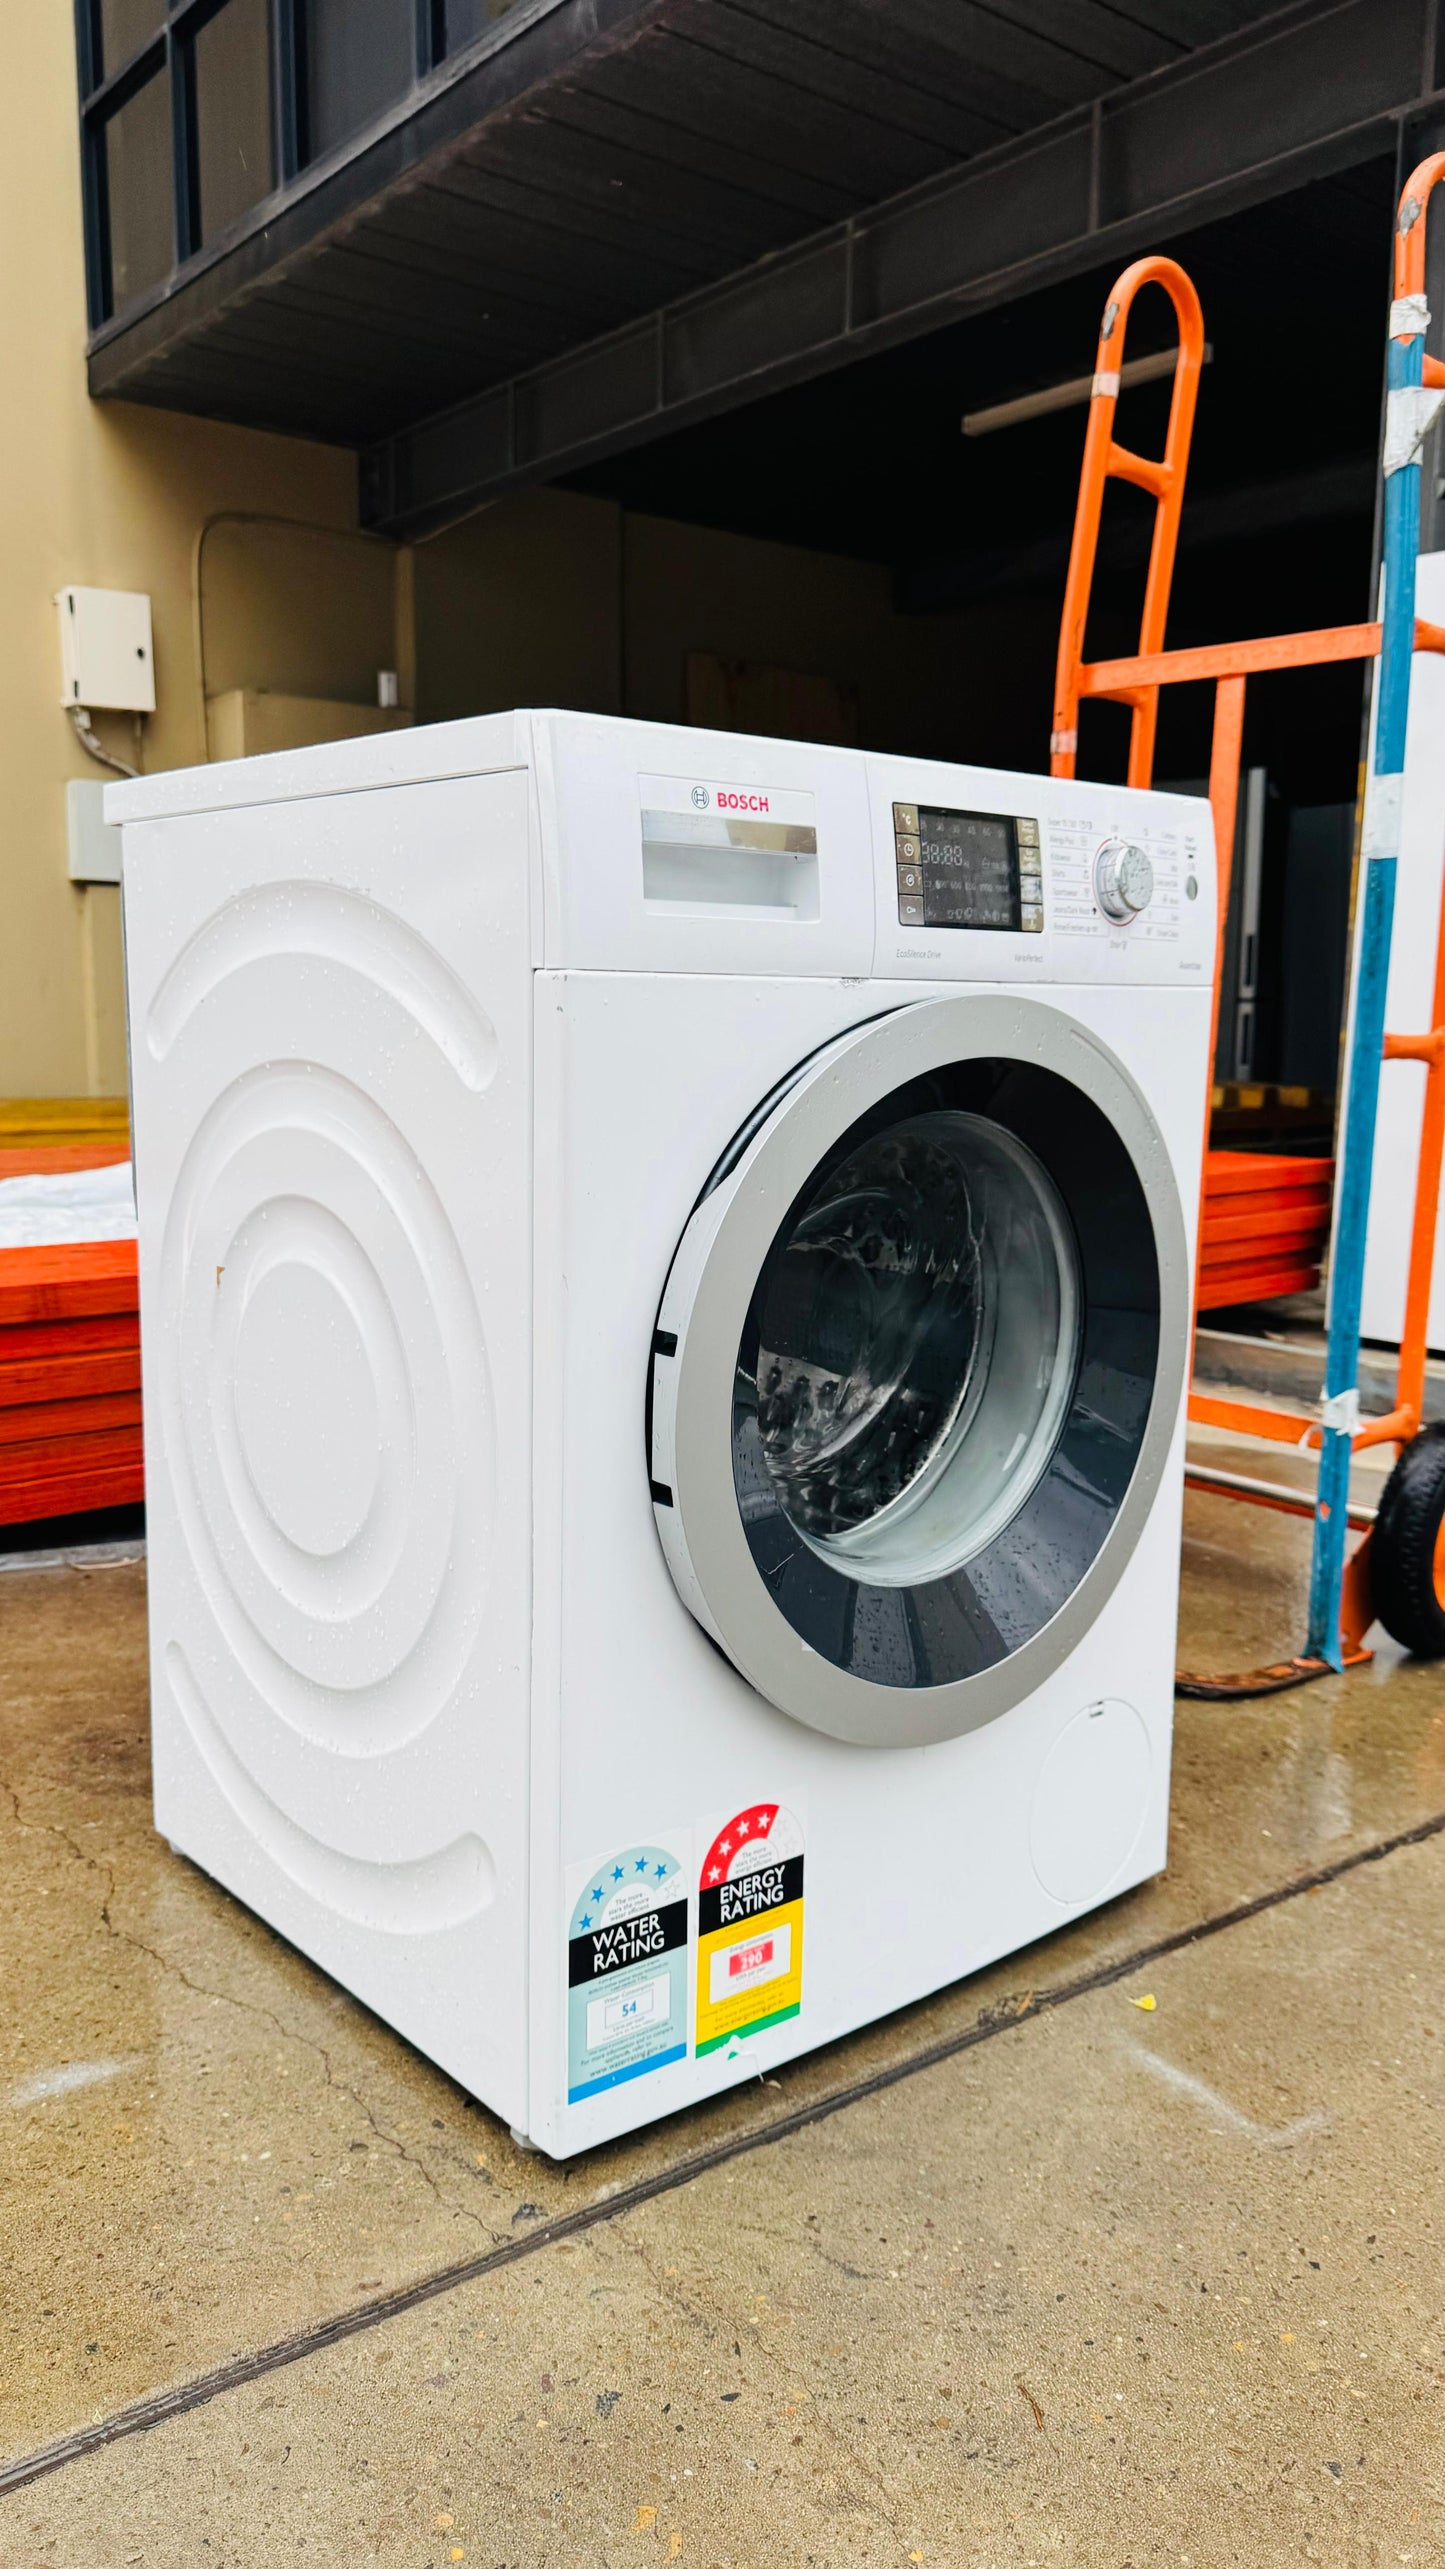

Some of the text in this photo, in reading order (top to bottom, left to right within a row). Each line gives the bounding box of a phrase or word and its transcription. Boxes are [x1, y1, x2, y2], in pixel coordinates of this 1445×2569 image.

[717, 792, 769, 812] BOSCH
[896, 950, 941, 960] EcoSilence Drive
[720, 1865, 785, 1904] ENERGY
[609, 1897, 650, 1916] stars the more
[628, 1893, 642, 1902] more
[721, 1884, 784, 1923] RATING
[611, 1903, 649, 1921] water efficient
[592, 1913, 660, 1952] WATER
[594, 1930, 665, 1973] RATING
[741, 1949, 763, 1971] 290
[622, 2000, 637, 2018] 54
